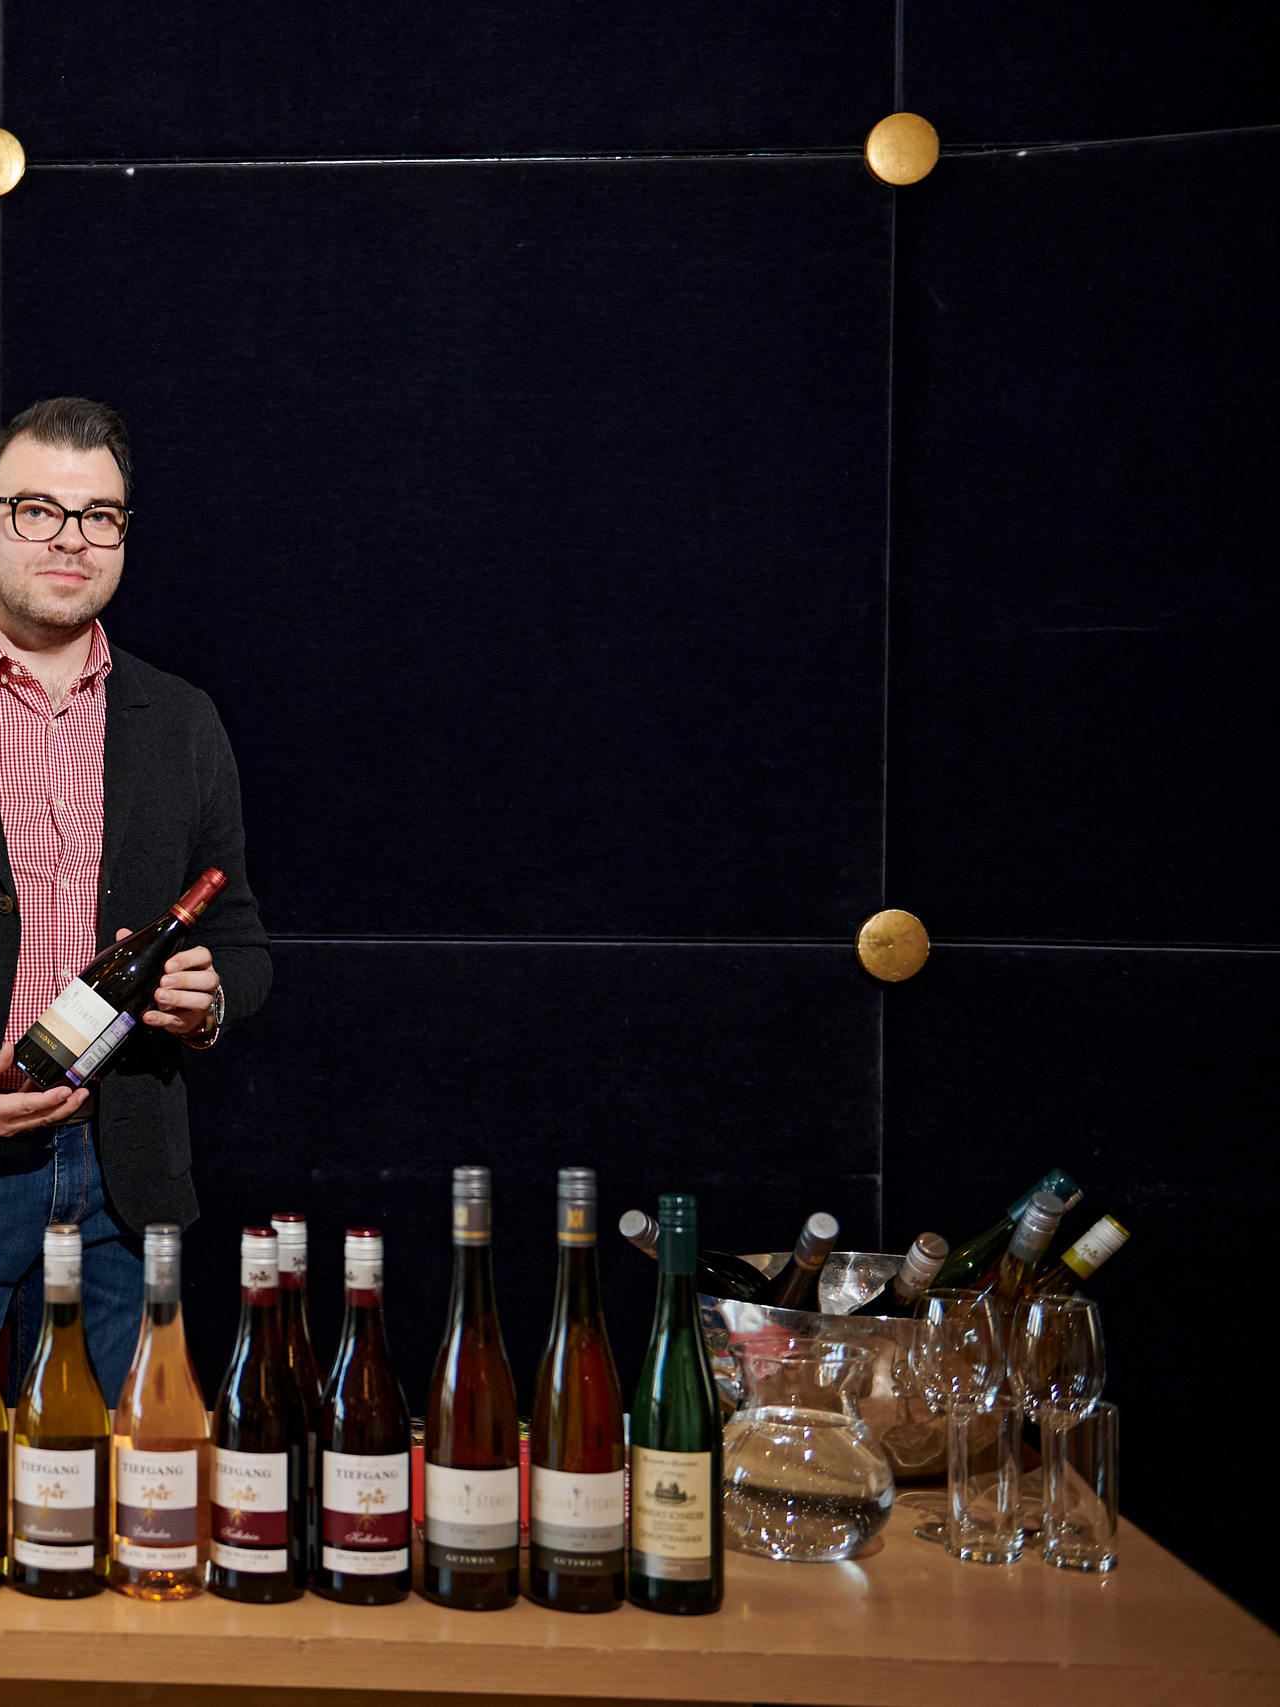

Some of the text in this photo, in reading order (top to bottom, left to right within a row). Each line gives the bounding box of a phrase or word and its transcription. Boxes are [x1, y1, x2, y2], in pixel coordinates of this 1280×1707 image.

[20, 1461, 80, 1475] TIEFGANG
[122, 1461, 184, 1475] TIEFGANG
[336, 1468, 399, 1480] TIEFGANG
[445, 1554, 496, 1564] GUTSWEIN
[552, 1556, 603, 1567] GUTSWEIN
